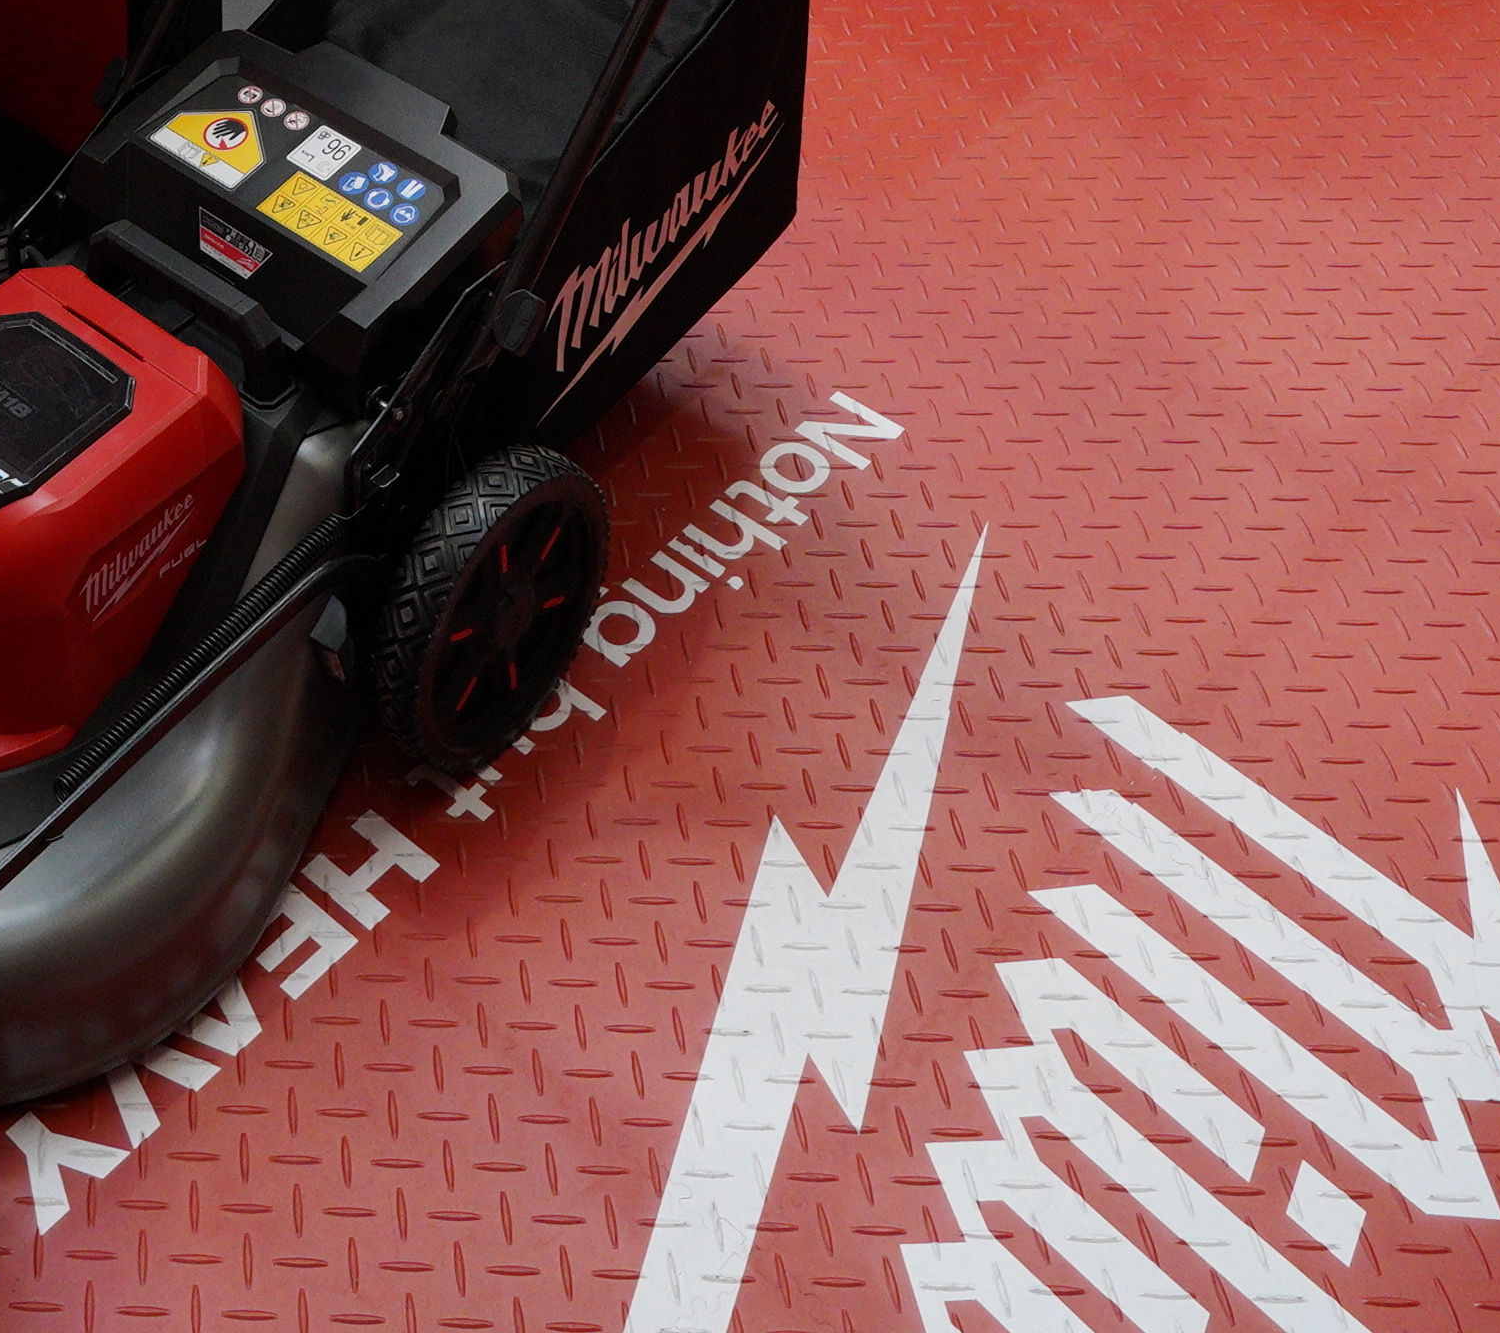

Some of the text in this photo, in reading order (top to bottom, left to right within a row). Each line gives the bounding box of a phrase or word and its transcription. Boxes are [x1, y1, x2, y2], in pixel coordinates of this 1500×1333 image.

[322, 139, 351, 161] 96
[555, 100, 781, 373] Milwaukee
[80, 490, 197, 619] Milwaukee
[159, 536, 207, 581] FUEL
[590, 390, 906, 669] Nothing
